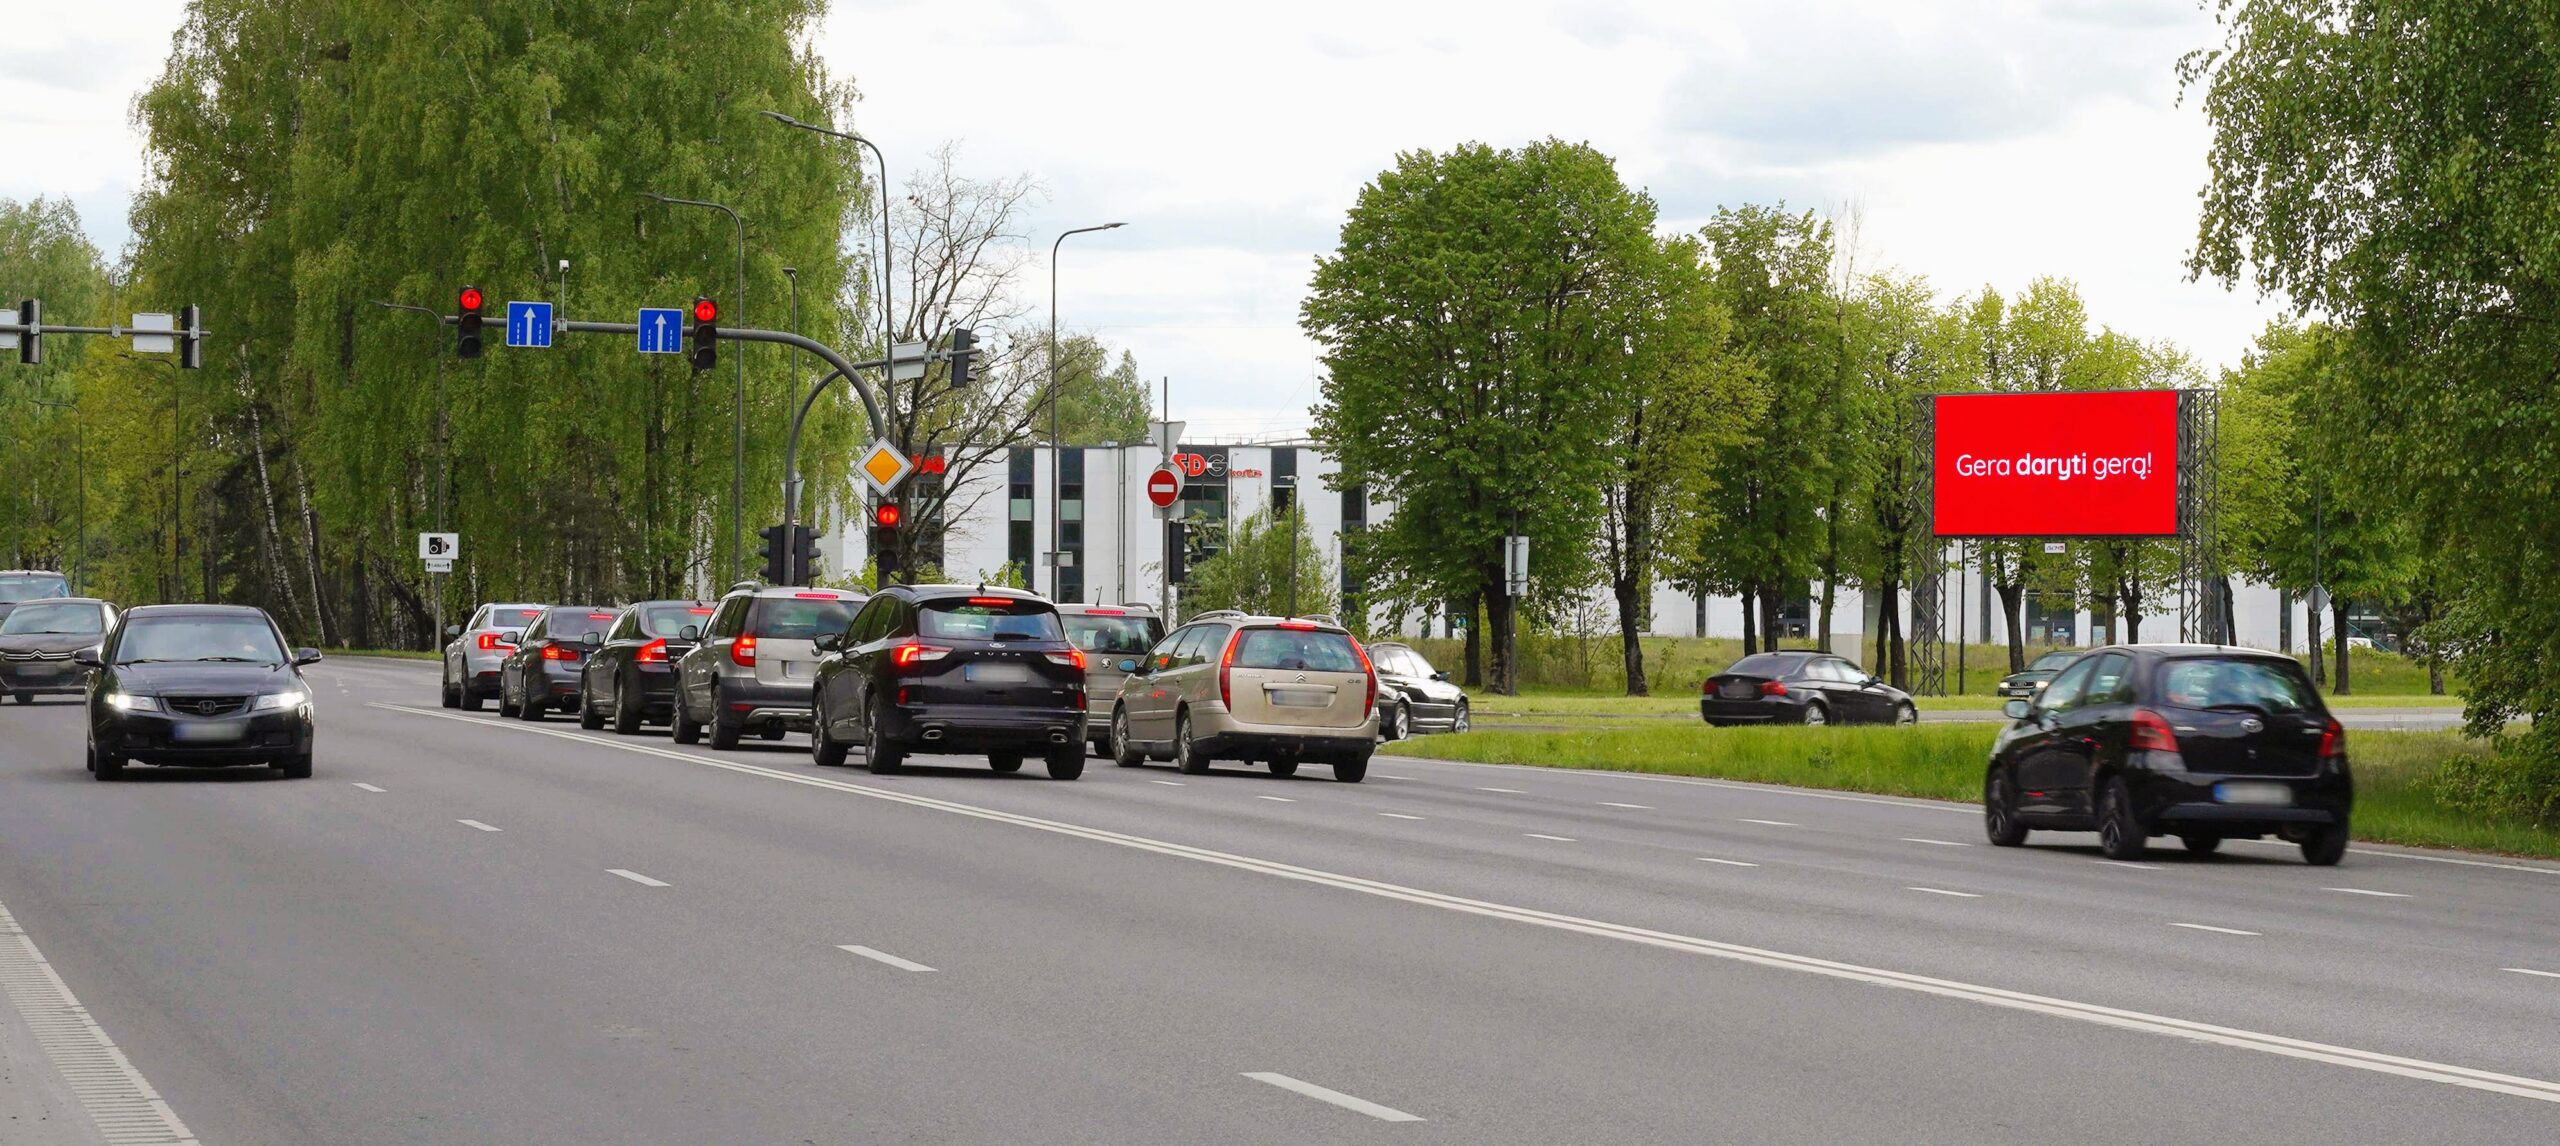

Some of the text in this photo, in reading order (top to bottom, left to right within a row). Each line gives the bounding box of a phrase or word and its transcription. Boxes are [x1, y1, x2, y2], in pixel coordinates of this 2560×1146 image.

[1173, 453, 1228, 477] SDG
[1956, 452, 2152, 481] Gera daryti gerą!
